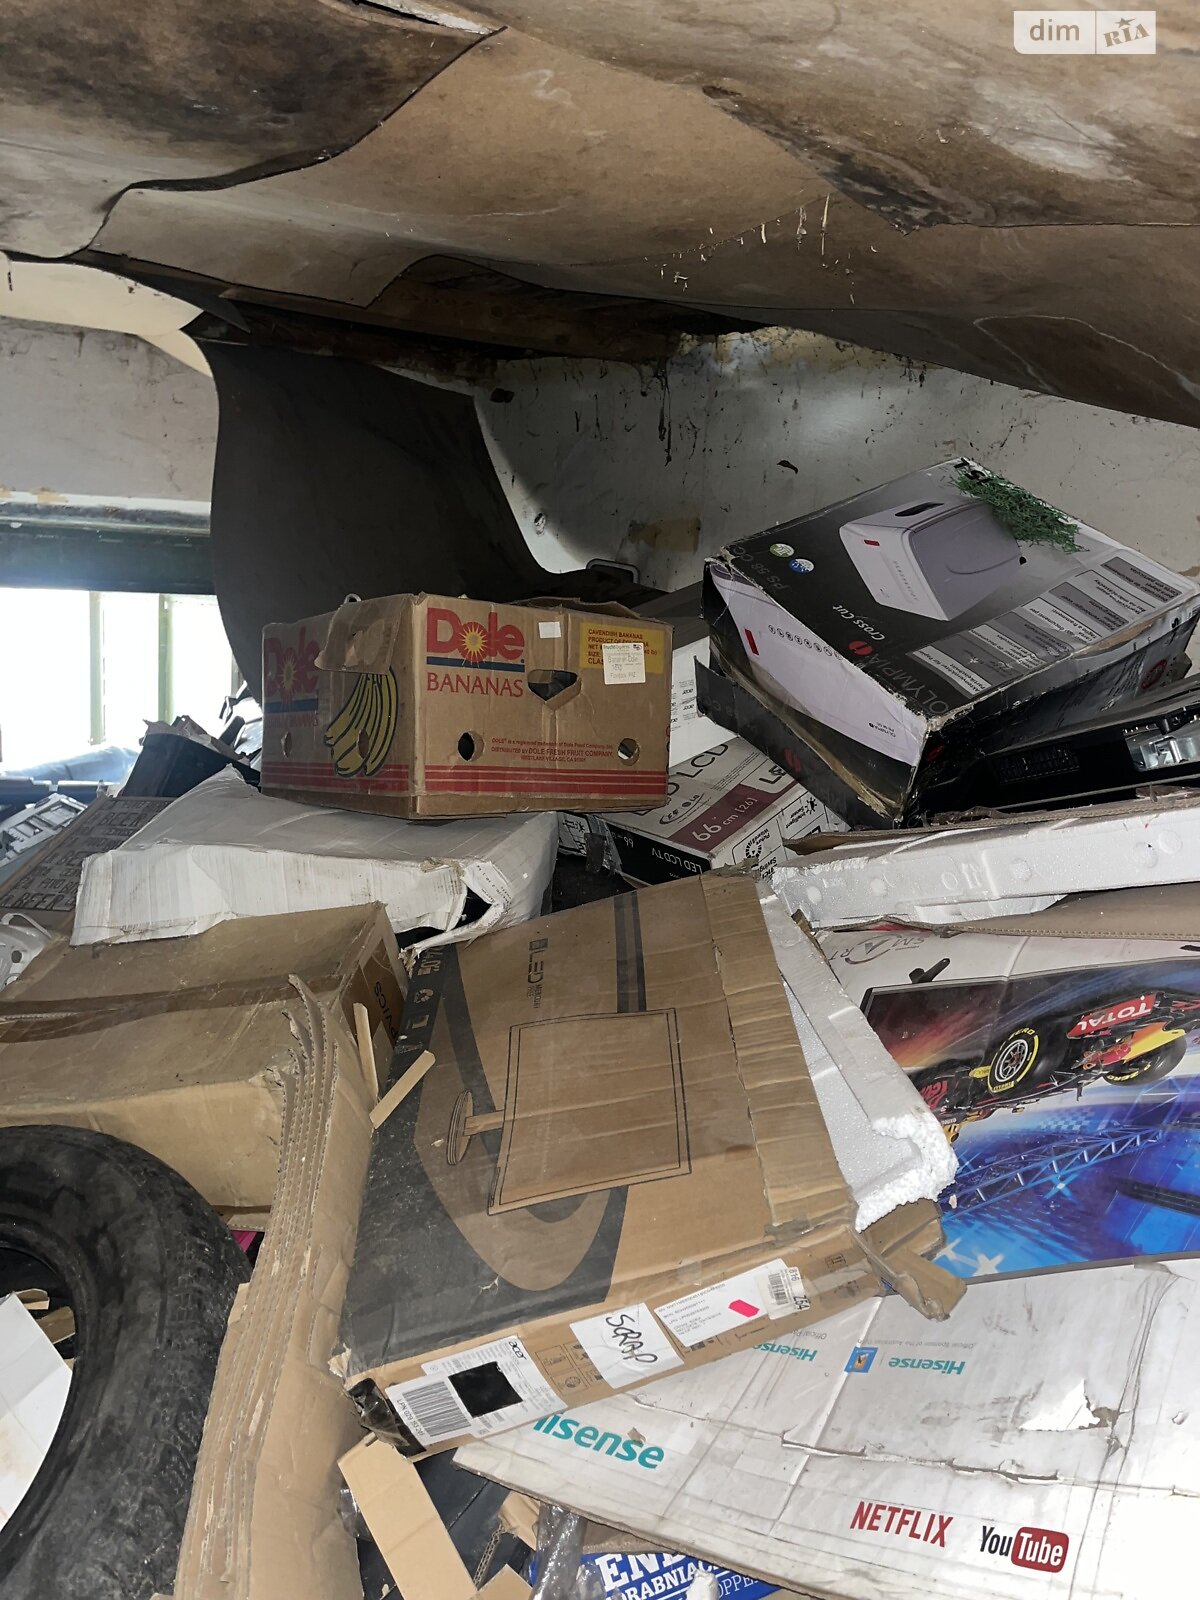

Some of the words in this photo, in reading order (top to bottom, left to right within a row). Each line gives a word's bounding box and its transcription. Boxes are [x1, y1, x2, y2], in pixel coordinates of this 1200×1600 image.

[832, 604, 855, 620] Cut
[426, 607, 525, 663] Dole
[618, 631, 643, 640] BANANAS
[853, 619, 885, 641] Cross
[427, 672, 524, 698] BANANAS
[866, 653, 949, 714] OLYMPIA
[528, 747, 545, 755] DOLE
[546, 748, 565, 756] FRESH
[676, 743, 729, 779] LCD
[692, 823, 723, 842] 66
[721, 812, 739, 826] cm
[651, 847, 665, 859] TV
[664, 852, 682, 866] LCD
[684, 860, 703, 875] LED
[1078, 998, 1150, 1031] TOTAL
[804, 1330, 828, 1340] Official
[508, 1341, 527, 1360] acer
[888, 1356, 966, 1375] Hisense
[850, 1501, 953, 1548] NETFLIX
[979, 1525, 1066, 1567] YouTube
